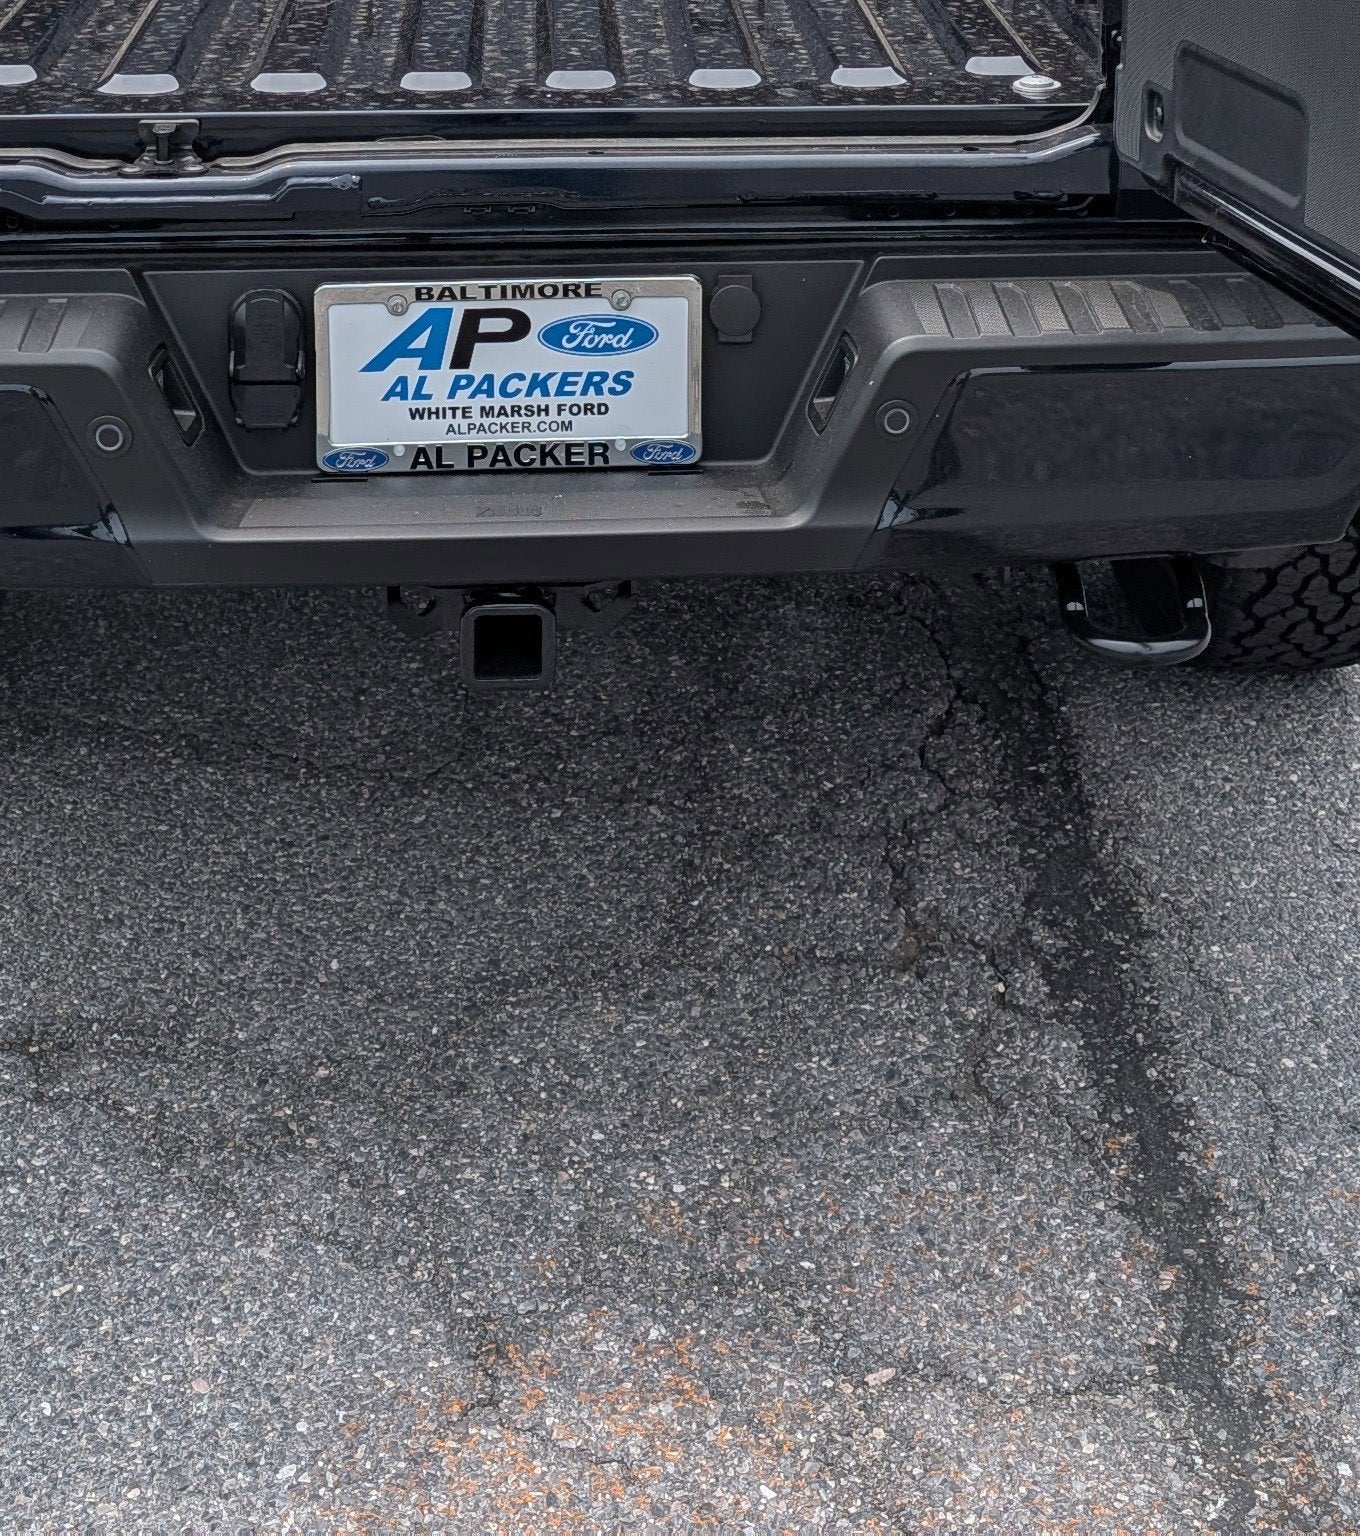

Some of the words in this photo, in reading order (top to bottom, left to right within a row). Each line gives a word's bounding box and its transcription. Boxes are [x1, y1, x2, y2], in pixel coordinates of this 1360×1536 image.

[414, 282, 603, 302] BALTIMORE
[561, 320, 634, 349] Ford
[381, 374, 433, 402] AL
[447, 370, 635, 400] PACKERS
[408, 406, 473, 421] WHITE
[480, 404, 549, 419] MARSH
[557, 402, 610, 417] FORD
[445, 420, 573, 436] ALPACKER.COM
[335, 450, 376, 469] Ford
[410, 445, 454, 471] AL
[467, 442, 610, 469] PACKER
[643, 444, 685, 462] Ford
